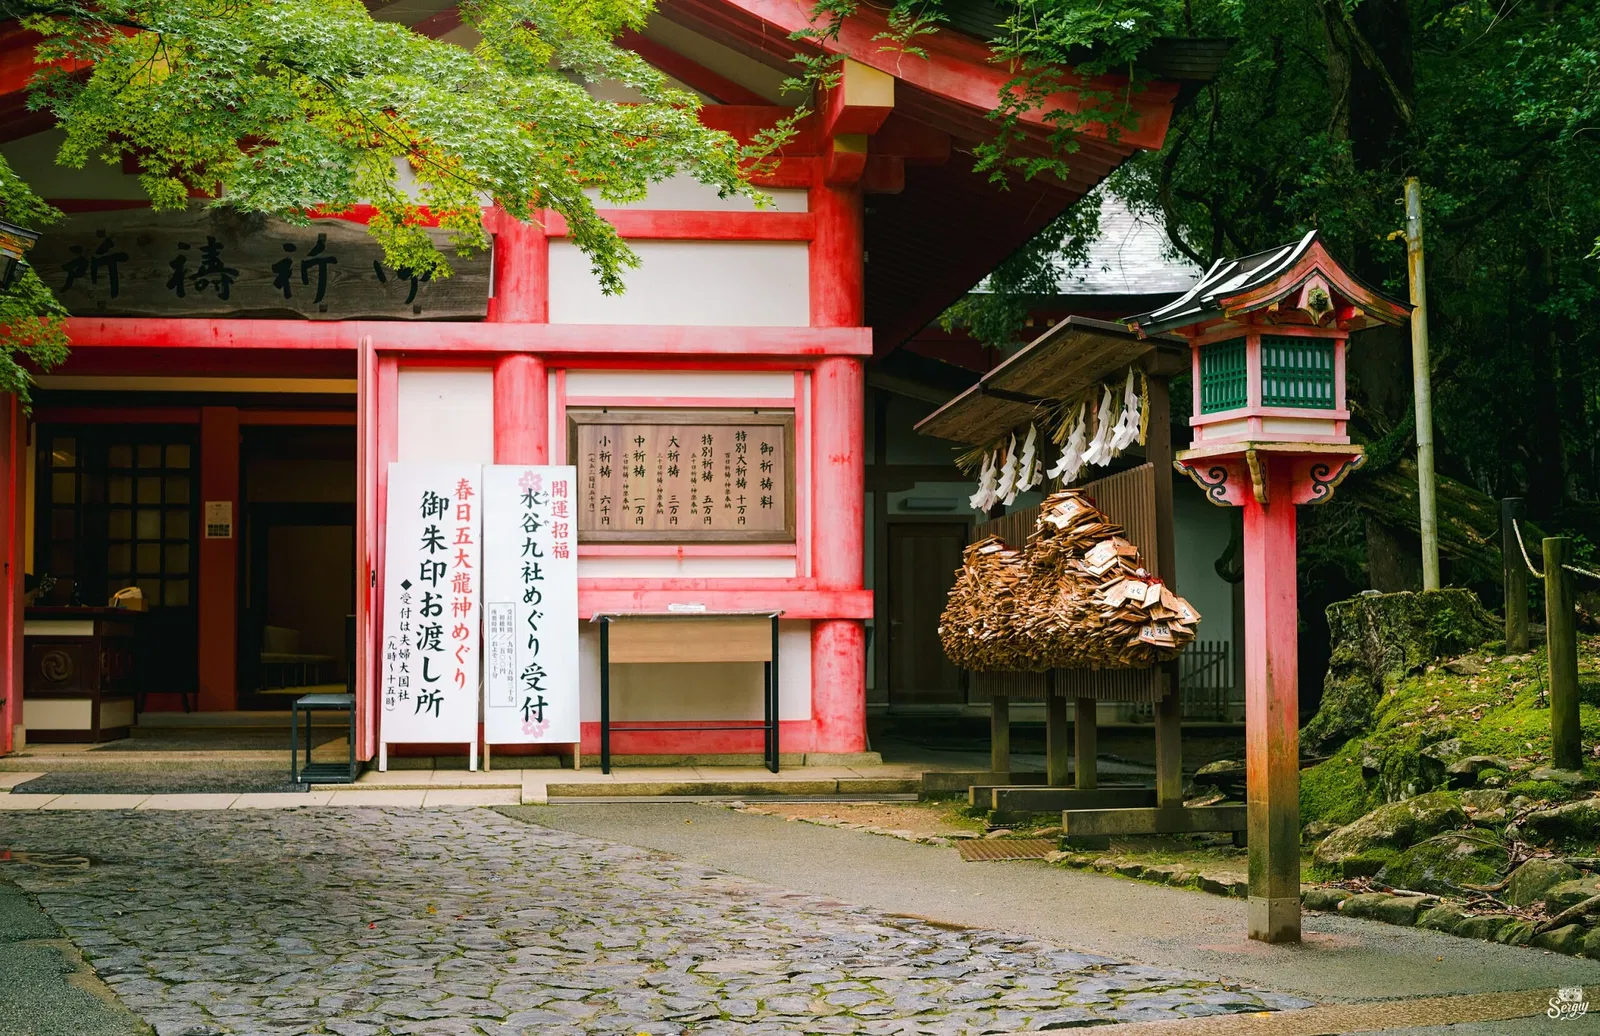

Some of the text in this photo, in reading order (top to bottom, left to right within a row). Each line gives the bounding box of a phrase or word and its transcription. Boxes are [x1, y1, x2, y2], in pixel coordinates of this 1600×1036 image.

[551, 480, 570, 560] 開運招福
[600, 495, 611, 525] 六千円
[634, 497, 645, 525] 一万円
[668, 495, 680, 525] 三万円
[702, 495, 713, 525] 五万円
[736, 495, 747, 525] 十万円
[450, 477, 475, 690] 春日五大龍神めぐり
[414, 490, 449, 719] 御朱印お渡し所
[520, 487, 548, 723] 水谷九社めぐり受付
